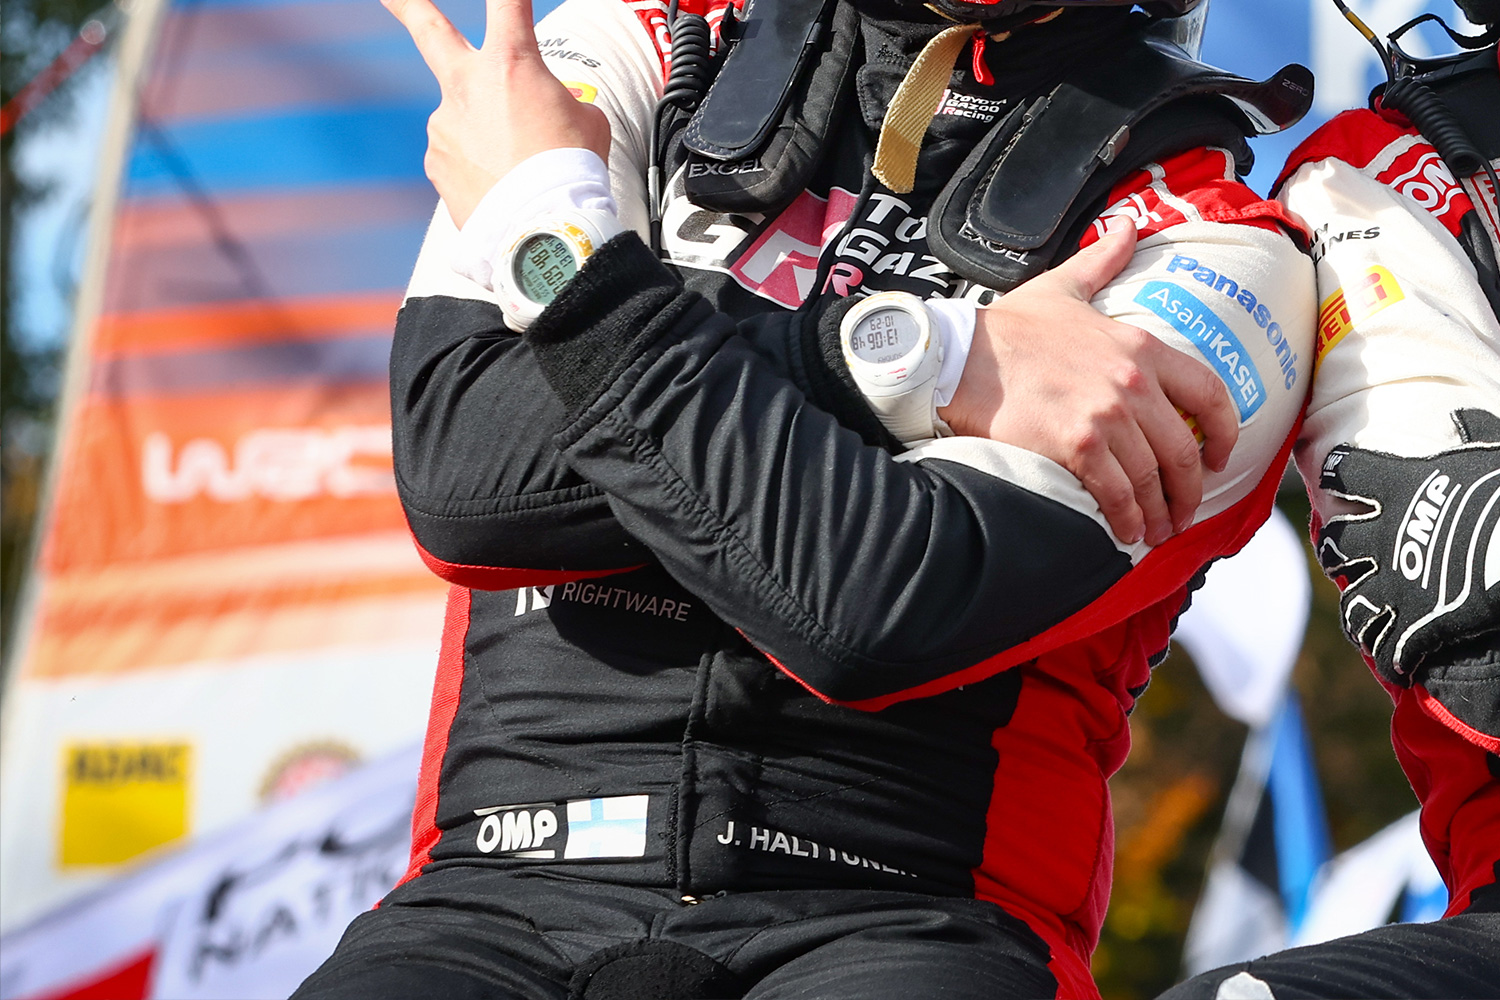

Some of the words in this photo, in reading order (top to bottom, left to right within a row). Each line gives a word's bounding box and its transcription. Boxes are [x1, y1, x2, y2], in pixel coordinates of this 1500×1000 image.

[946, 99, 1000, 113] GAZOO
[952, 91, 1007, 105] TOYOTA
[942, 106, 995, 124] Racing
[870, 315, 894, 331] 10-29
[1166, 254, 1297, 391] Panasonic
[868, 328, 899, 351] 13:06
[1322, 453, 1344, 471] MP
[1400, 473, 1451, 581] OMP
[562, 581, 692, 622] RIGHTWARE
[476, 809, 558, 855] OMP
[717, 820, 741, 846] J.
